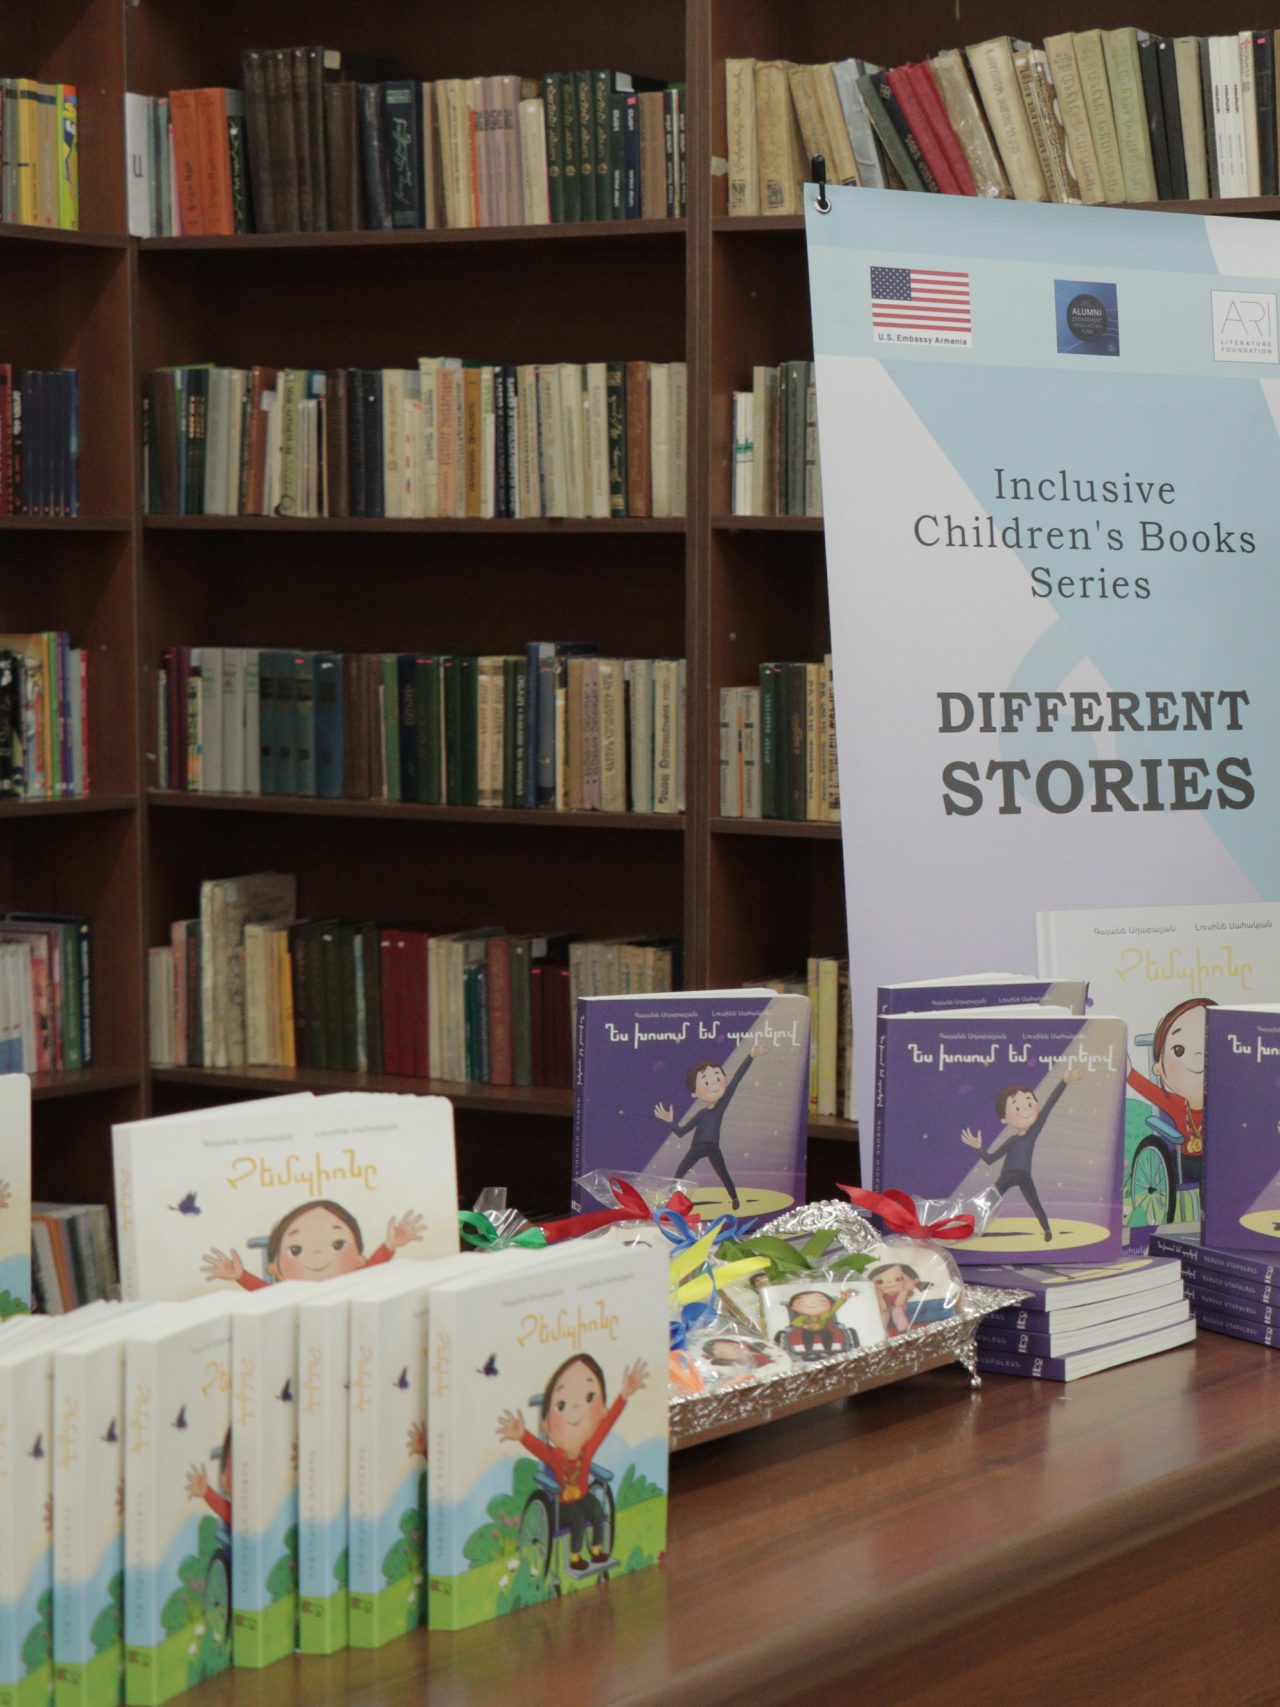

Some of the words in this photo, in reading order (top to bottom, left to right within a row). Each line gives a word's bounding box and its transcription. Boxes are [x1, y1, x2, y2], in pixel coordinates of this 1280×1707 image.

[1072, 307, 1102, 317] ALUMNI
[878, 333, 894, 342] U.S.
[897, 334, 932, 345] Embassy
[935, 336, 967, 346] Armenia
[1220, 339, 1271, 348] LITERATURE
[1221, 346, 1272, 354] FOUNDATION
[994, 467, 1176, 505] Inclusive
[913, 515, 1124, 552] Children's
[1140, 521, 1256, 555] Books
[1030, 567, 1151, 600] Series
[936, 690, 1250, 733] DIFFERENT
[942, 756, 1255, 816] STORIES
[605, 1023, 629, 1042] Ես
[634, 1022, 690, 1049] խոսում
[699, 1021, 720, 1040] եմ
[727, 1020, 800, 1047] պարելով
[1227, 1034, 1252, 1054] Ես
[908, 1043, 933, 1063] Ես
[939, 1043, 999, 1071] խոսում
[1008, 1043, 1031, 1063] եմ
[1038, 1043, 1118, 1072] պարելով
[226, 1149, 377, 1197] Չեմպիոնը
[516, 1299, 618, 1350] Չեմպիոնը
